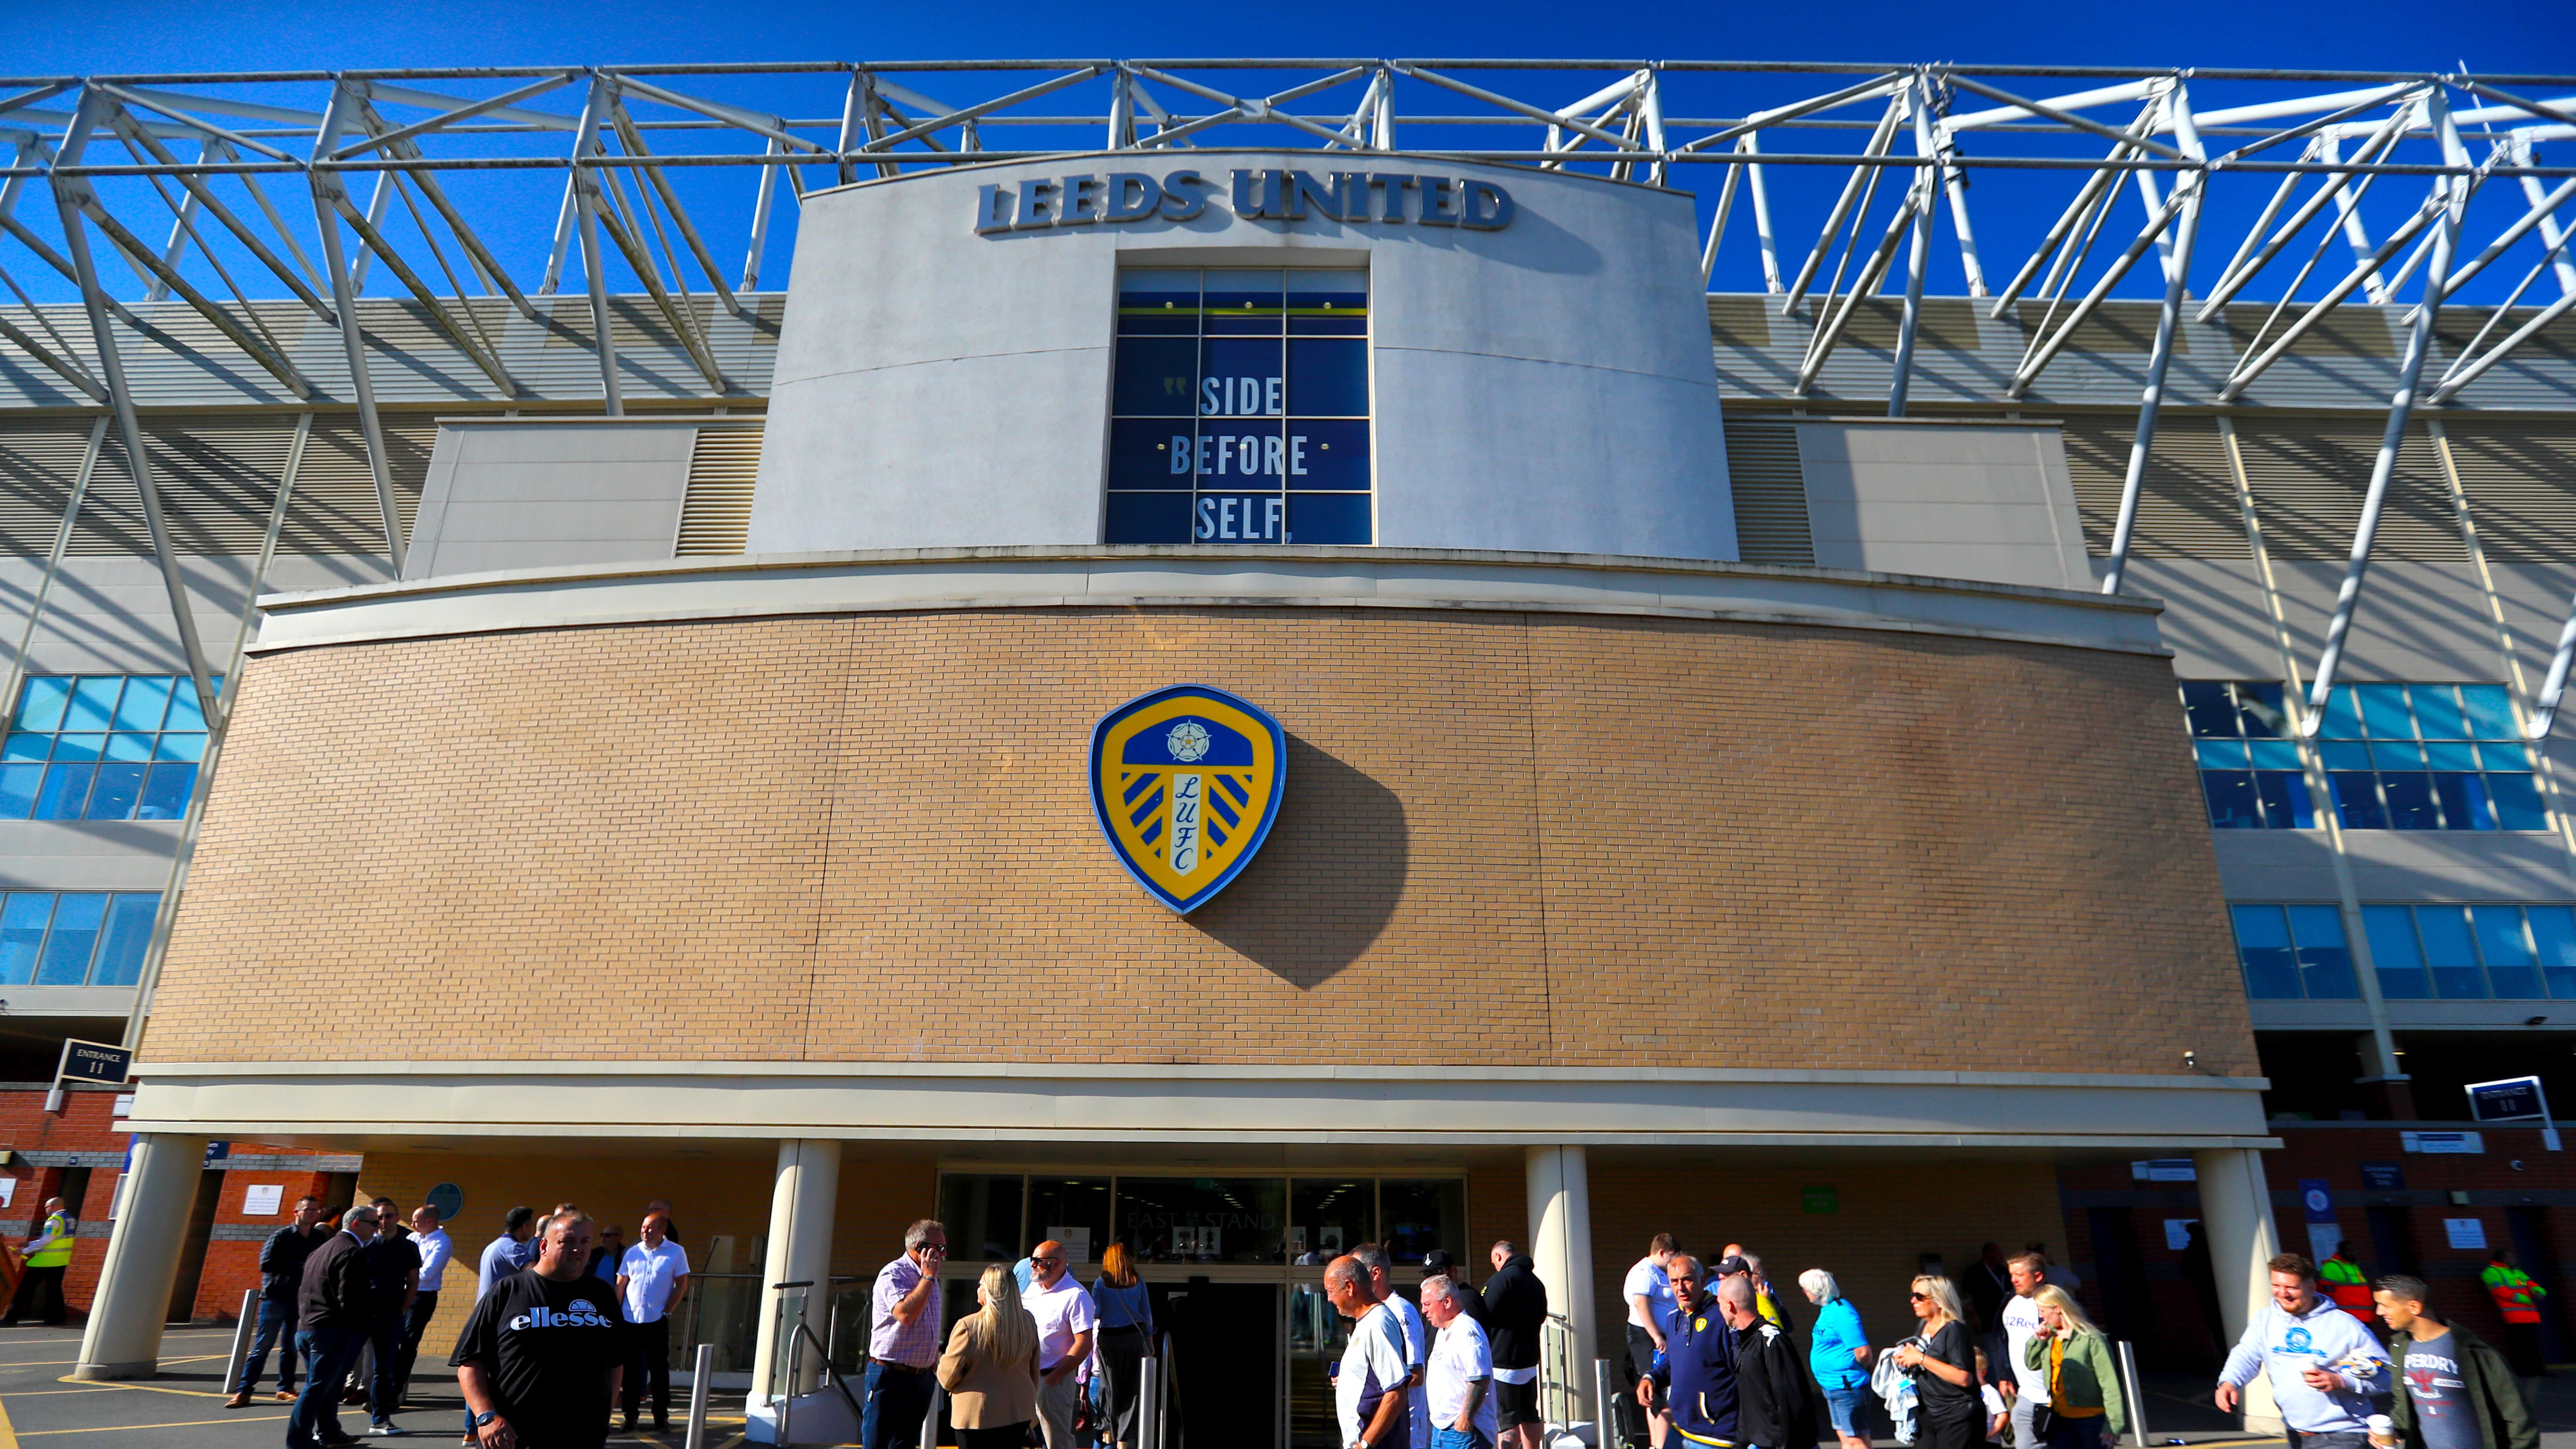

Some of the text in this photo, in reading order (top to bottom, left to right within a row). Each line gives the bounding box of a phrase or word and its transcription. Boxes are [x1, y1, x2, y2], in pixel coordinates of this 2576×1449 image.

[974, 168, 1515, 234] LEEDS UNITED
[1170, 435, 1307, 475] BEFORE
[77, 1049, 121, 1063] ENTRANCE
[89, 1061, 104, 1074] 11
[1127, 1211, 1276, 1230] EAST STAND
[510, 1306, 612, 1330] ellesse
[2404, 1353, 2458, 1374] PERDRY
